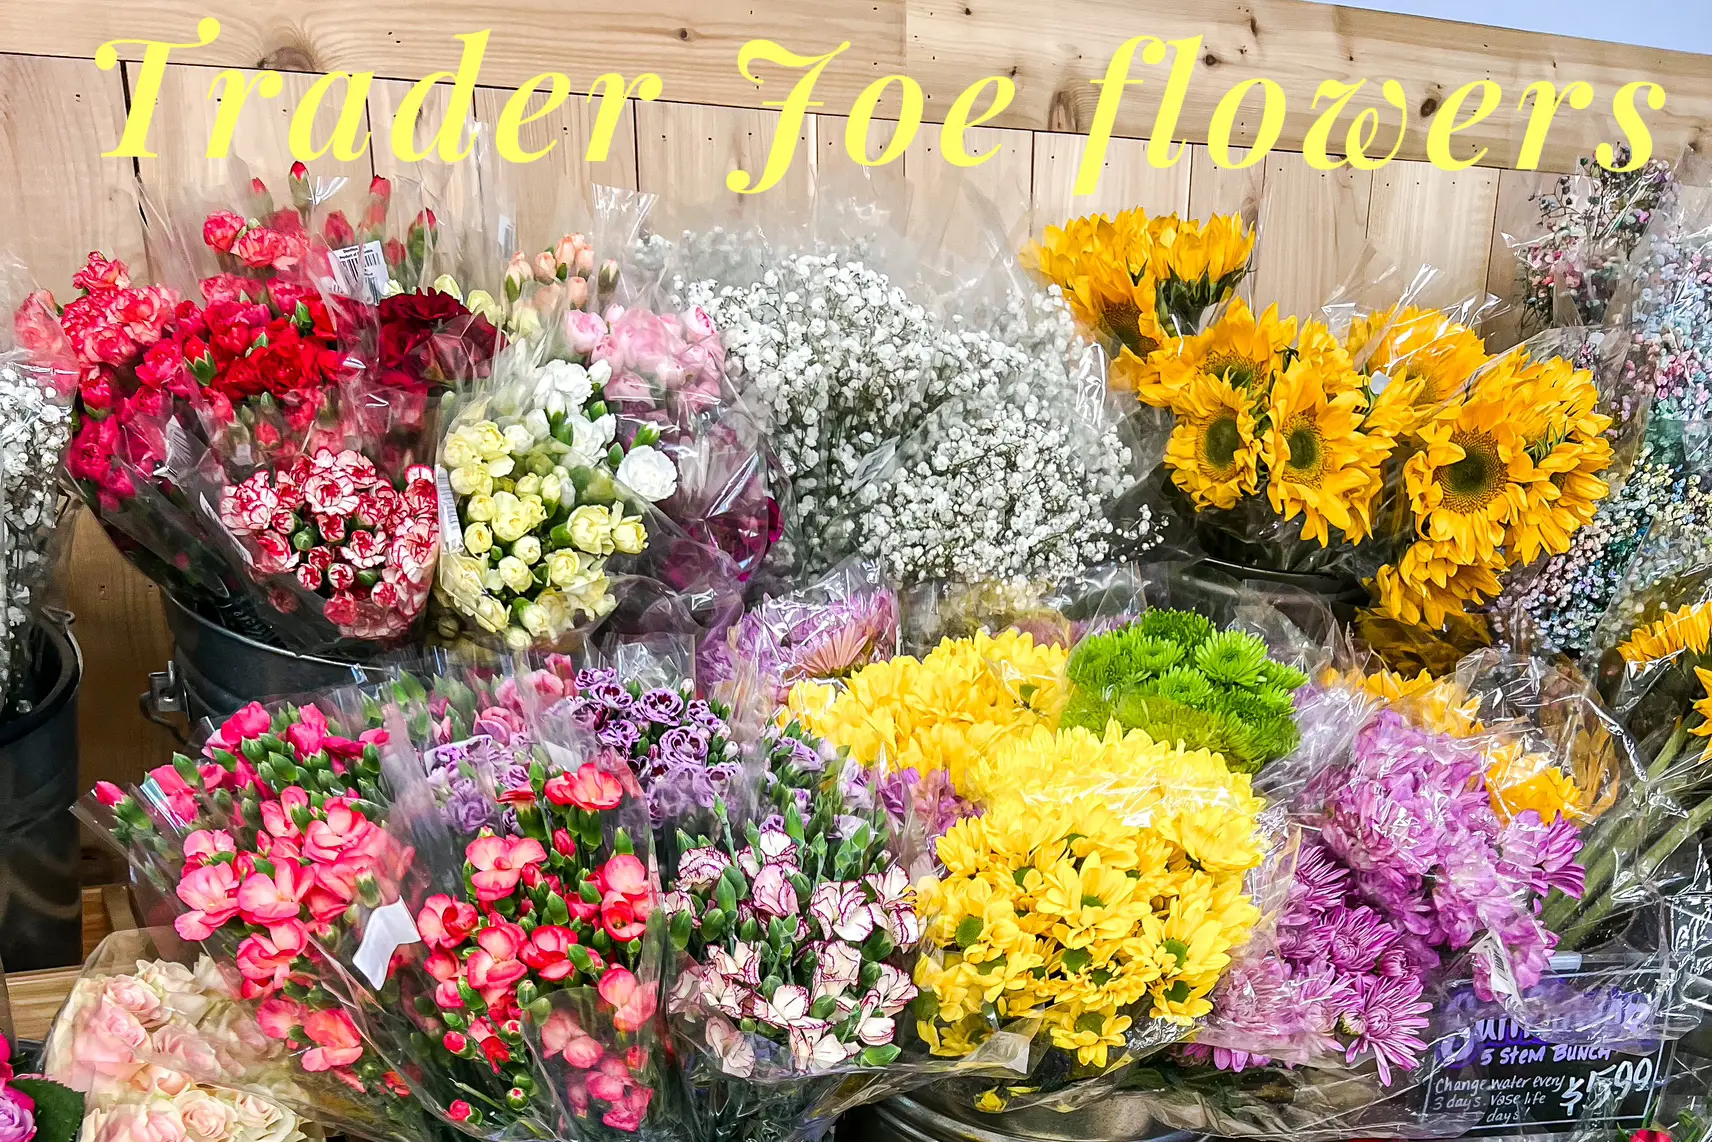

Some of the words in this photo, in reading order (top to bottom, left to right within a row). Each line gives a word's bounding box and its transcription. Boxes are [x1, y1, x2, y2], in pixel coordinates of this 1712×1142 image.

[1480, 1049, 1493, 1066] 5
[1553, 1044, 1611, 1063] BUNCH
[1435, 1077, 1487, 1097] Change
[1491, 1075, 1531, 1090] water
[1533, 1075, 1565, 1093] every
[1524, 1091, 1546, 1105] life
